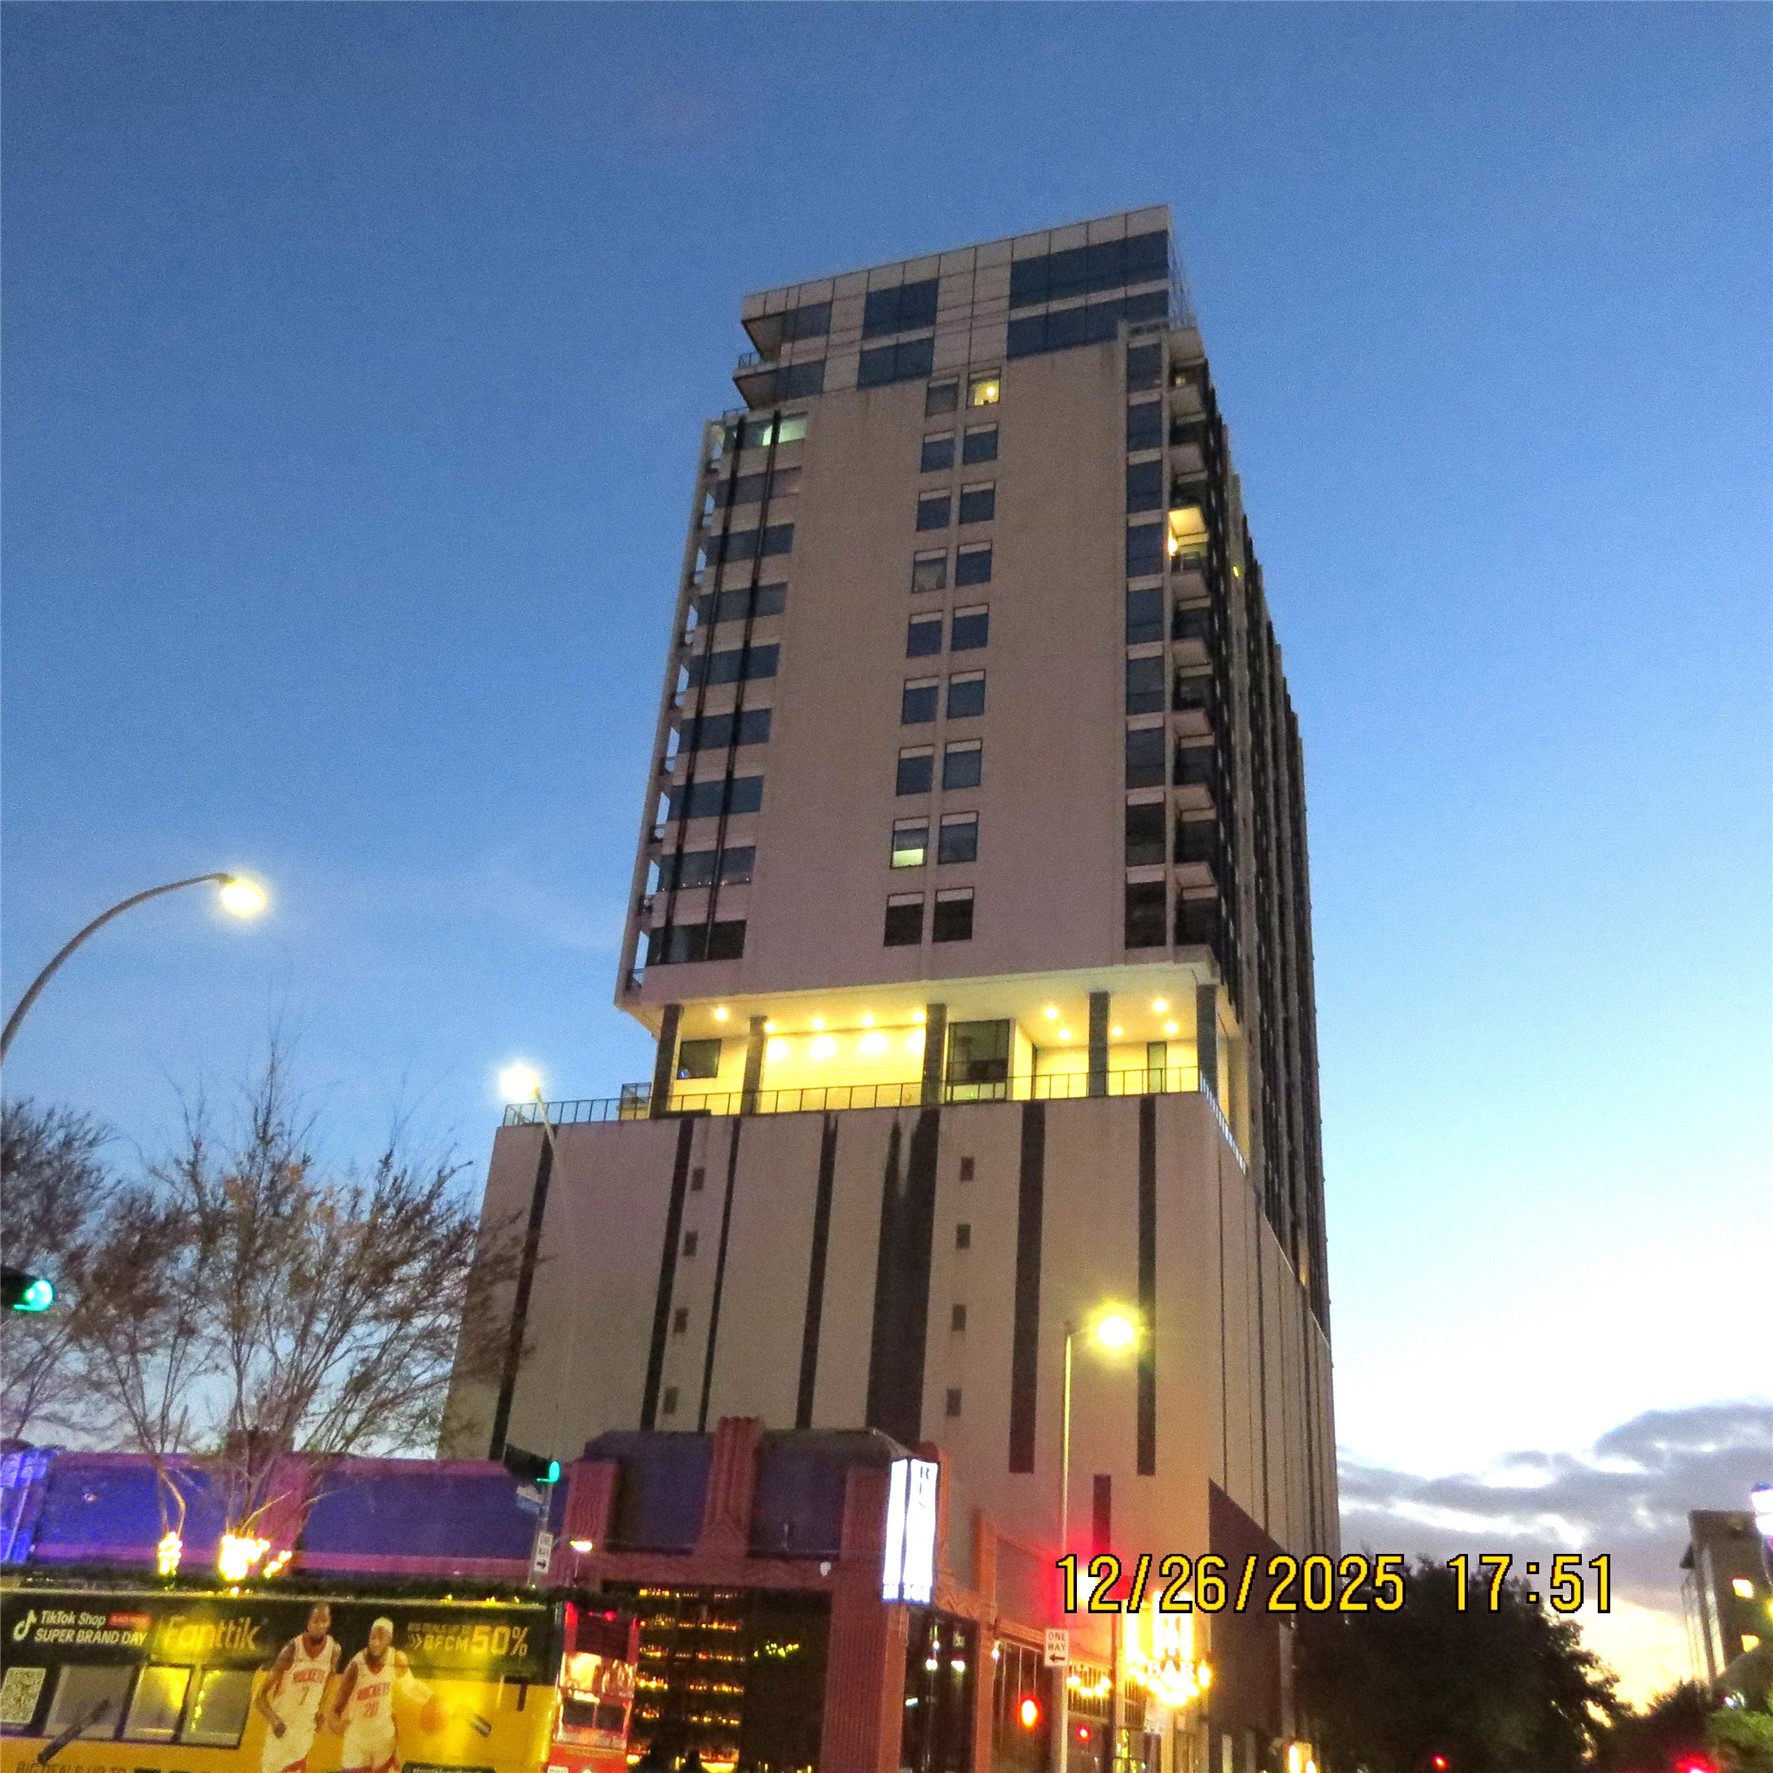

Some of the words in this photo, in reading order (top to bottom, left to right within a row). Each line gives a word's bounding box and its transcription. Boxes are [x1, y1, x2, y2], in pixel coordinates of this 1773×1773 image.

[41, 1610, 76, 1626] TikTok
[78, 1611, 106, 1628] Shop
[34, 1628, 75, 1643] SUPER
[76, 1629, 120, 1645] BRAND
[121, 1631, 148, 1646] DAY
[471, 1624, 529, 1657] 50%
[1047, 1631, 1067, 1642] ONE
[1047, 1642, 1067, 1652] WAY
[1146, 1660, 1196, 1678] BAR
